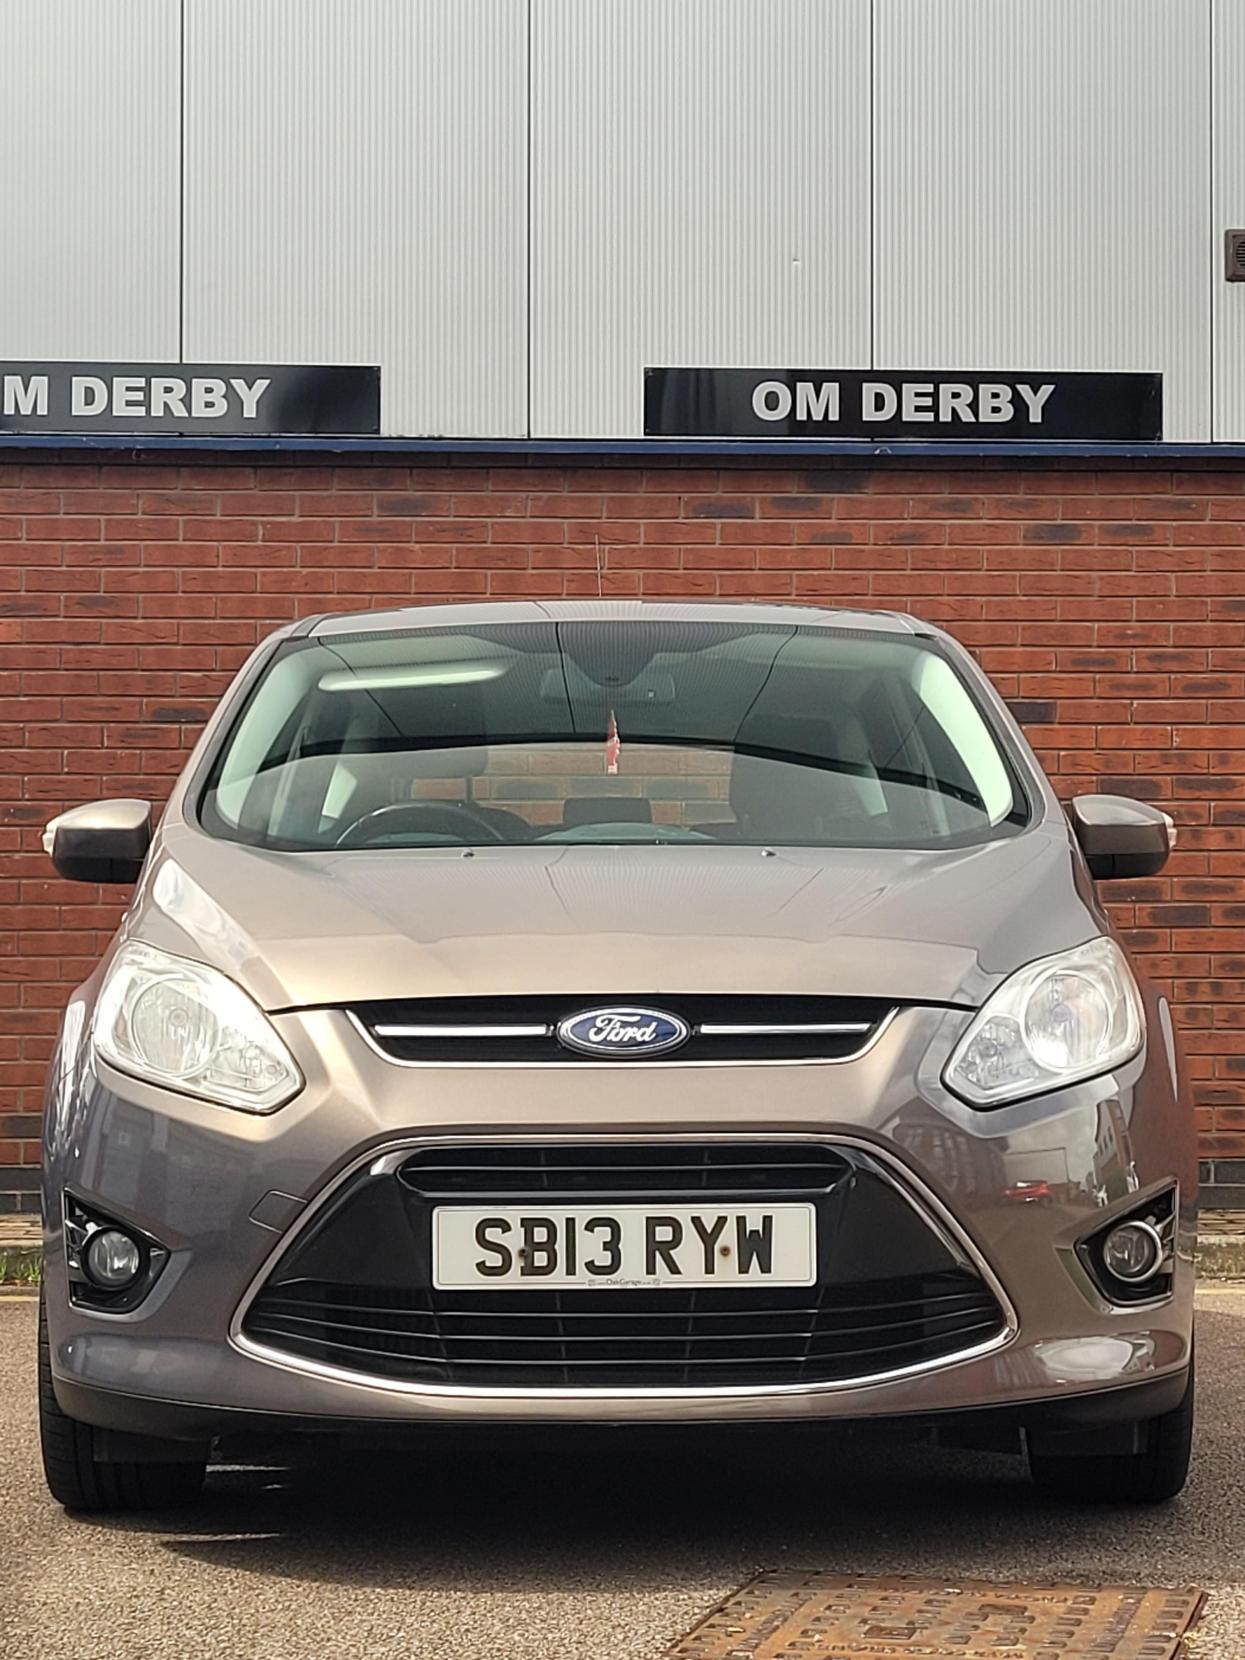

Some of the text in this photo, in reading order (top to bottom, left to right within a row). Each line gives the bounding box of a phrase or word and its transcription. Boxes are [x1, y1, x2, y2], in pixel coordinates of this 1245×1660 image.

[71, 376, 272, 418] DERBY
[751, 380, 1056, 423] OM DERBY
[588, 1014, 659, 1043] Ford
[474, 1214, 775, 1277] SB13 RYW
